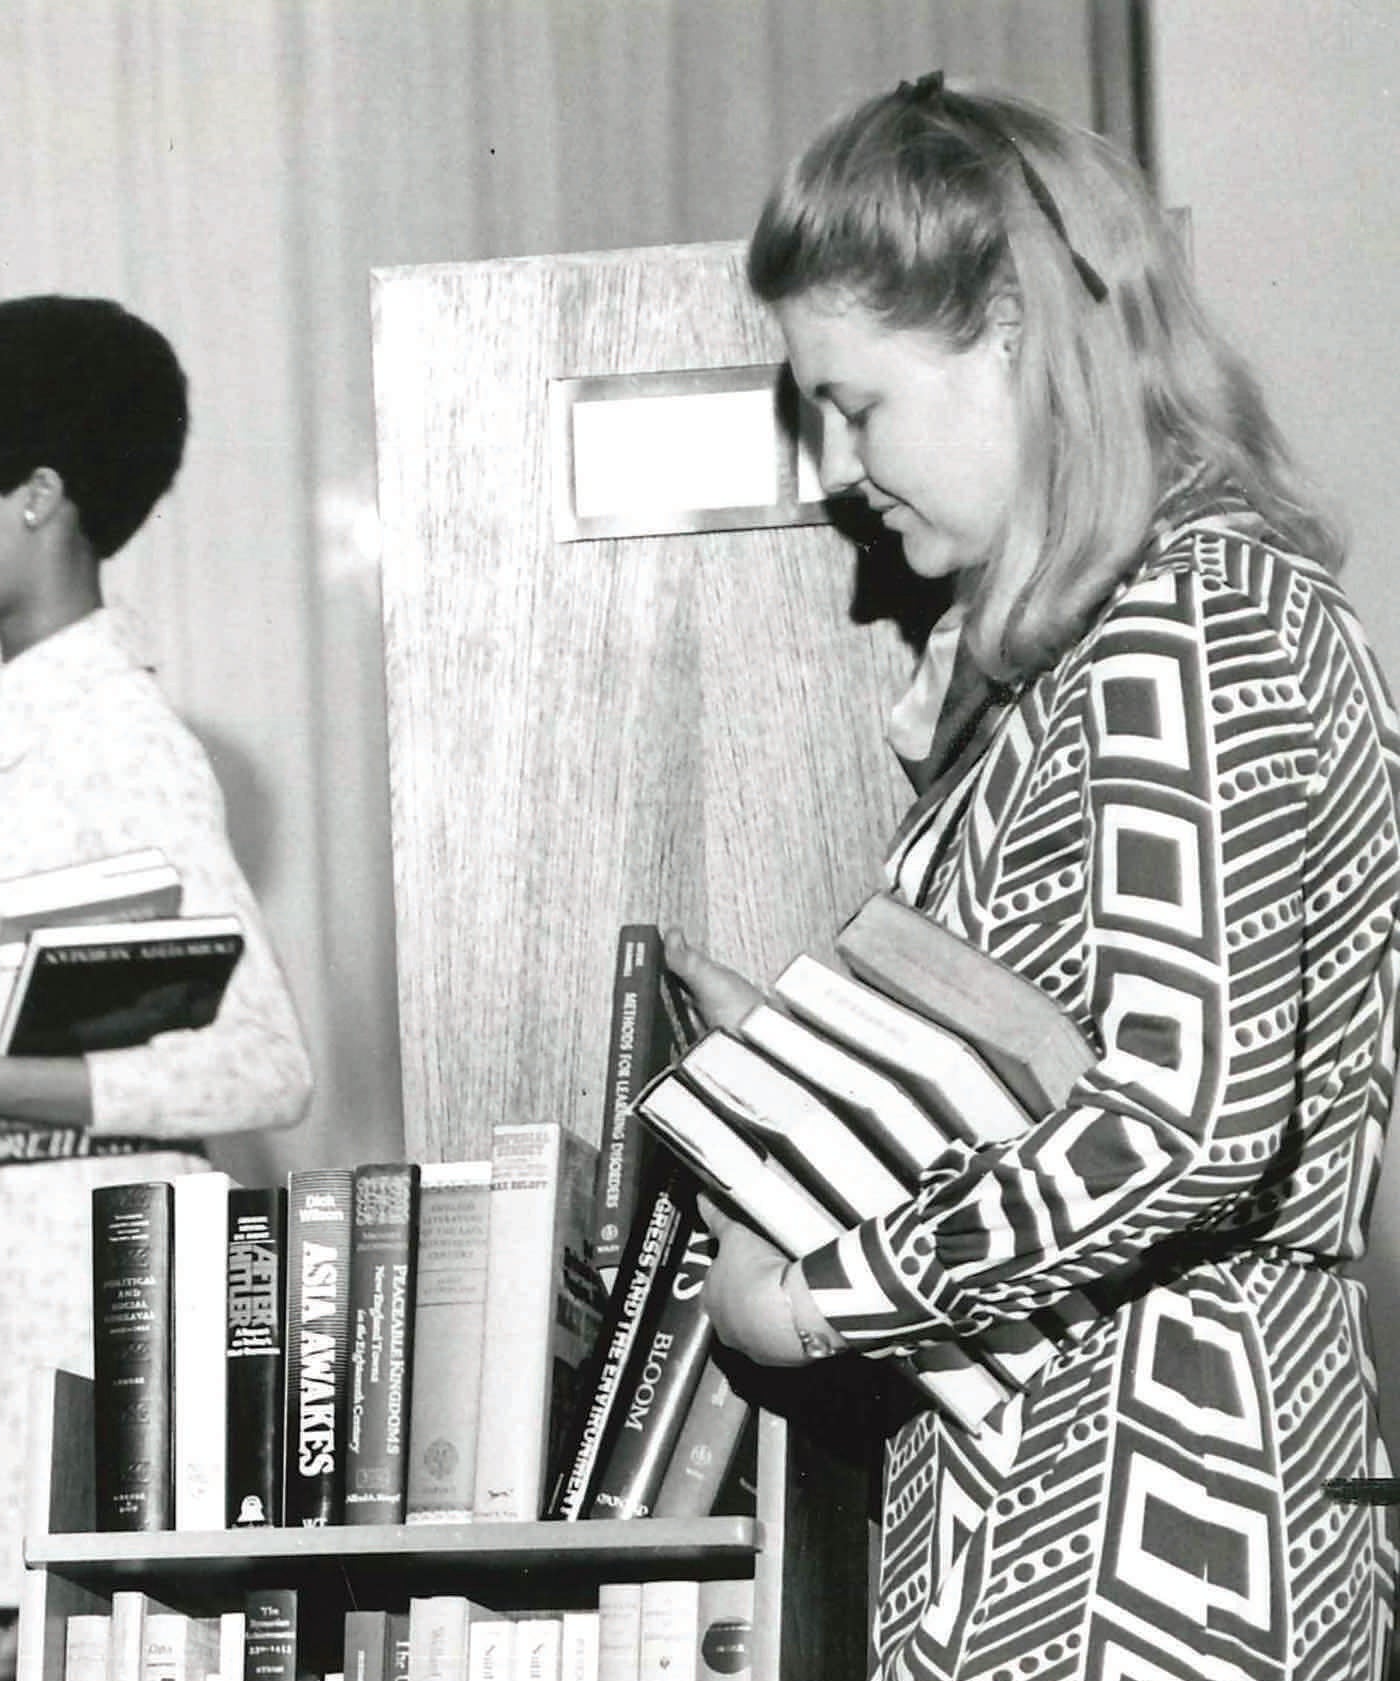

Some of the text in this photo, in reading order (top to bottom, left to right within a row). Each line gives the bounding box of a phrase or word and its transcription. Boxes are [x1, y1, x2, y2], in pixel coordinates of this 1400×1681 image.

[605, 992, 637, 1208] METHODS FOR LEARNING DISORDERS
[228, 1245, 252, 1328] HITLER
[250, 1245, 278, 1328] AFTER
[302, 1241, 337, 1322] ASIA
[624, 1271, 655, 1318] AND
[355, 1323, 366, 1339] the
[370, 1265, 385, 1383] New England Towns
[386, 1265, 407, 1455] PEACEABLE KINGDOMS
[607, 1320, 635, 1359] THE
[298, 1330, 336, 1477] AWAKES
[351, 1341, 366, 1404] Eighteenth
[624, 1330, 673, 1432] BLOOM
[349, 1405, 363, 1453] Century
[558, 1364, 618, 1523] ENVIRONMENT
[260, 1606, 280, 1616] The
[393, 1640, 410, 1669] The
[481, 1644, 497, 1680] Saint
[529, 1642, 545, 1680] Saint
